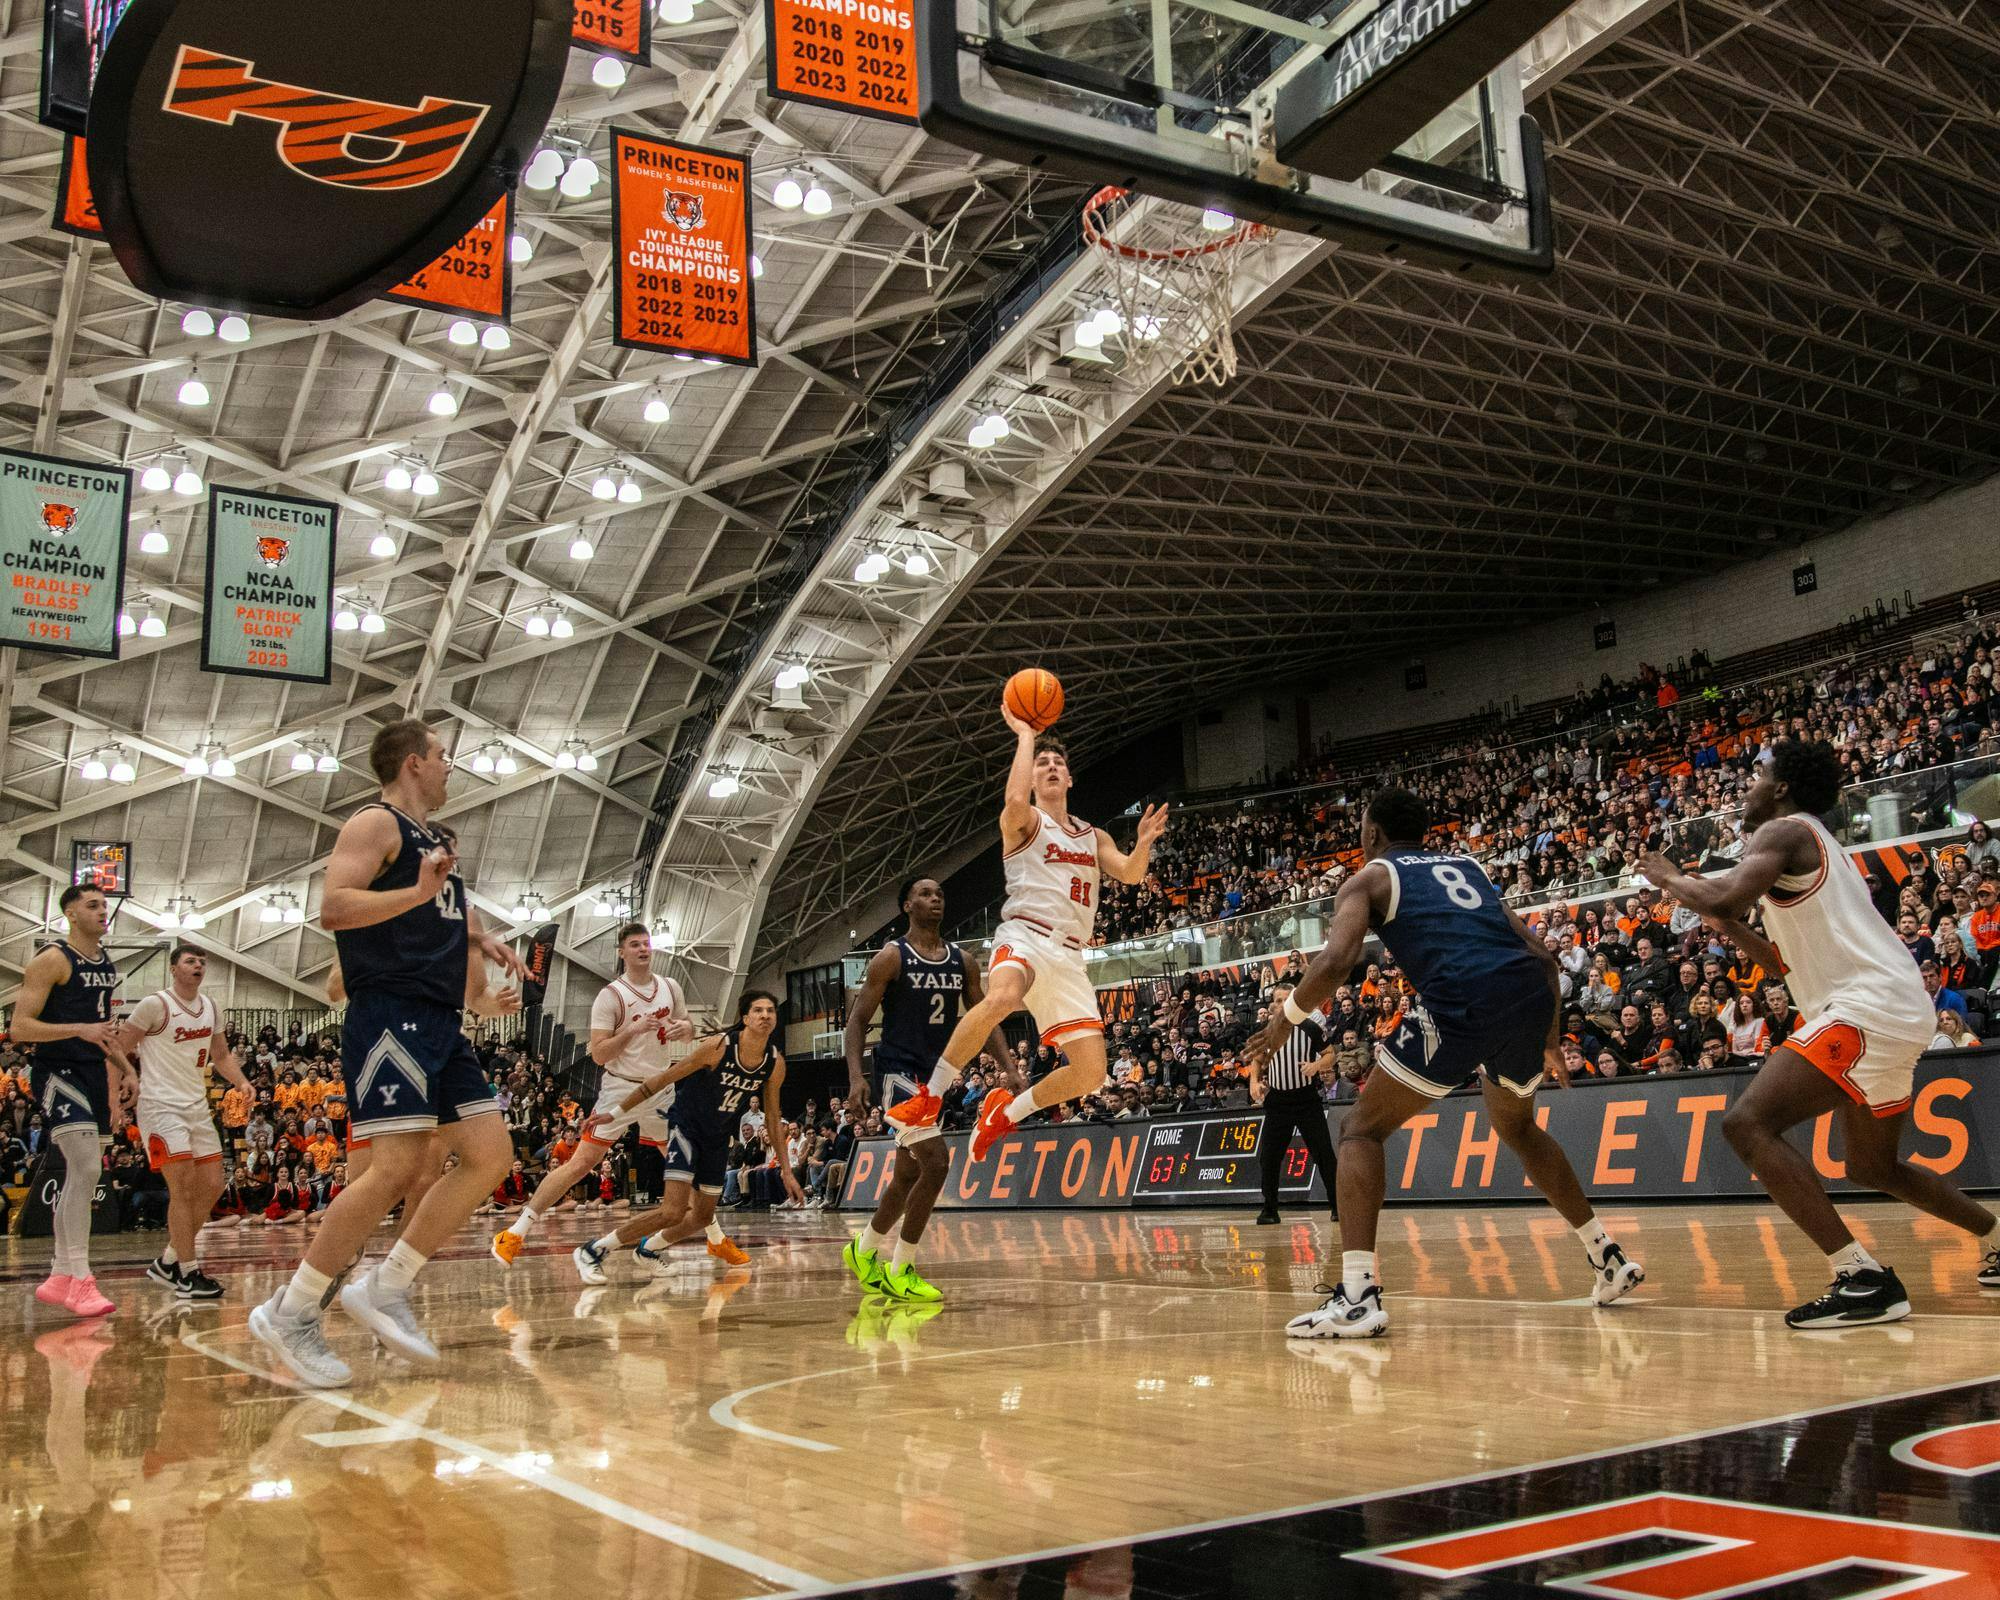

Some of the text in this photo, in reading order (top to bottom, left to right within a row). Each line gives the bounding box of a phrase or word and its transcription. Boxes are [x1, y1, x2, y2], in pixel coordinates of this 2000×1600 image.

[784, 0, 912, 30] AMPIONS
[791, 14, 904, 56] 2018 2019
[793, 40, 907, 81] 2020 2022
[794, 66, 908, 106] 2023 2024
[624, 145, 740, 183] PRINCETON
[627, 165, 735, 193] WOMEN'S BASKETBALL
[645, 227, 724, 252] IVY LEAGUE
[638, 239, 731, 266] TOURNAMENT
[440, 254, 491, 280] 2023
[628, 251, 741, 284] CHAMPIONS
[636, 273, 738, 305] 2018 2019
[637, 296, 739, 326] 2022 2023
[638, 319, 684, 340] 2024
[3, 462, 119, 494] PRINCETON
[221, 499, 326, 528] PRINCETON
[29, 538, 81, 560] NCAA
[3, 552, 105, 580] CHAMPION
[13, 573, 92, 597] BRADLEY
[246, 571, 294, 590] NCAA
[1797, 572, 1815, 587] 303
[223, 585, 317, 609] CHAMPION
[12, 606, 88, 625] HEAVYWEIGHT
[235, 605, 302, 626] PATRICK
[27, 621, 71, 641] 1951
[243, 622, 293, 640] GLORY
[250, 638, 267, 648] 125
[247, 650, 288, 668] 2023
[1484, 751, 1497, 762] 202
[1243, 799, 1256, 808] 201
[1070, 876, 1092, 908] 21
[1431, 864, 1483, 910] 8
[80, 971, 116, 988] YALE
[907, 972, 964, 991] YALE
[97, 990, 107, 1019] 4
[928, 993, 945, 1025] 2
[1395, 1024, 1415, 1049] Y
[719, 1071, 764, 1092] YALE
[378, 1083, 400, 1107] Y
[717, 1089, 743, 1113] 14
[57, 1102, 72, 1123] Y
[1153, 1128, 1184, 1147] HOME
[1219, 1123, 1257, 1151] 1:46
[847, 1135, 1140, 1201] PRCETON
[1149, 1155, 1175, 1184] 63
[1197, 1167, 1225, 1181] PERIOD
[1225, 1163, 1237, 1184] 2
[1286, 1147, 1309, 1178] 73
